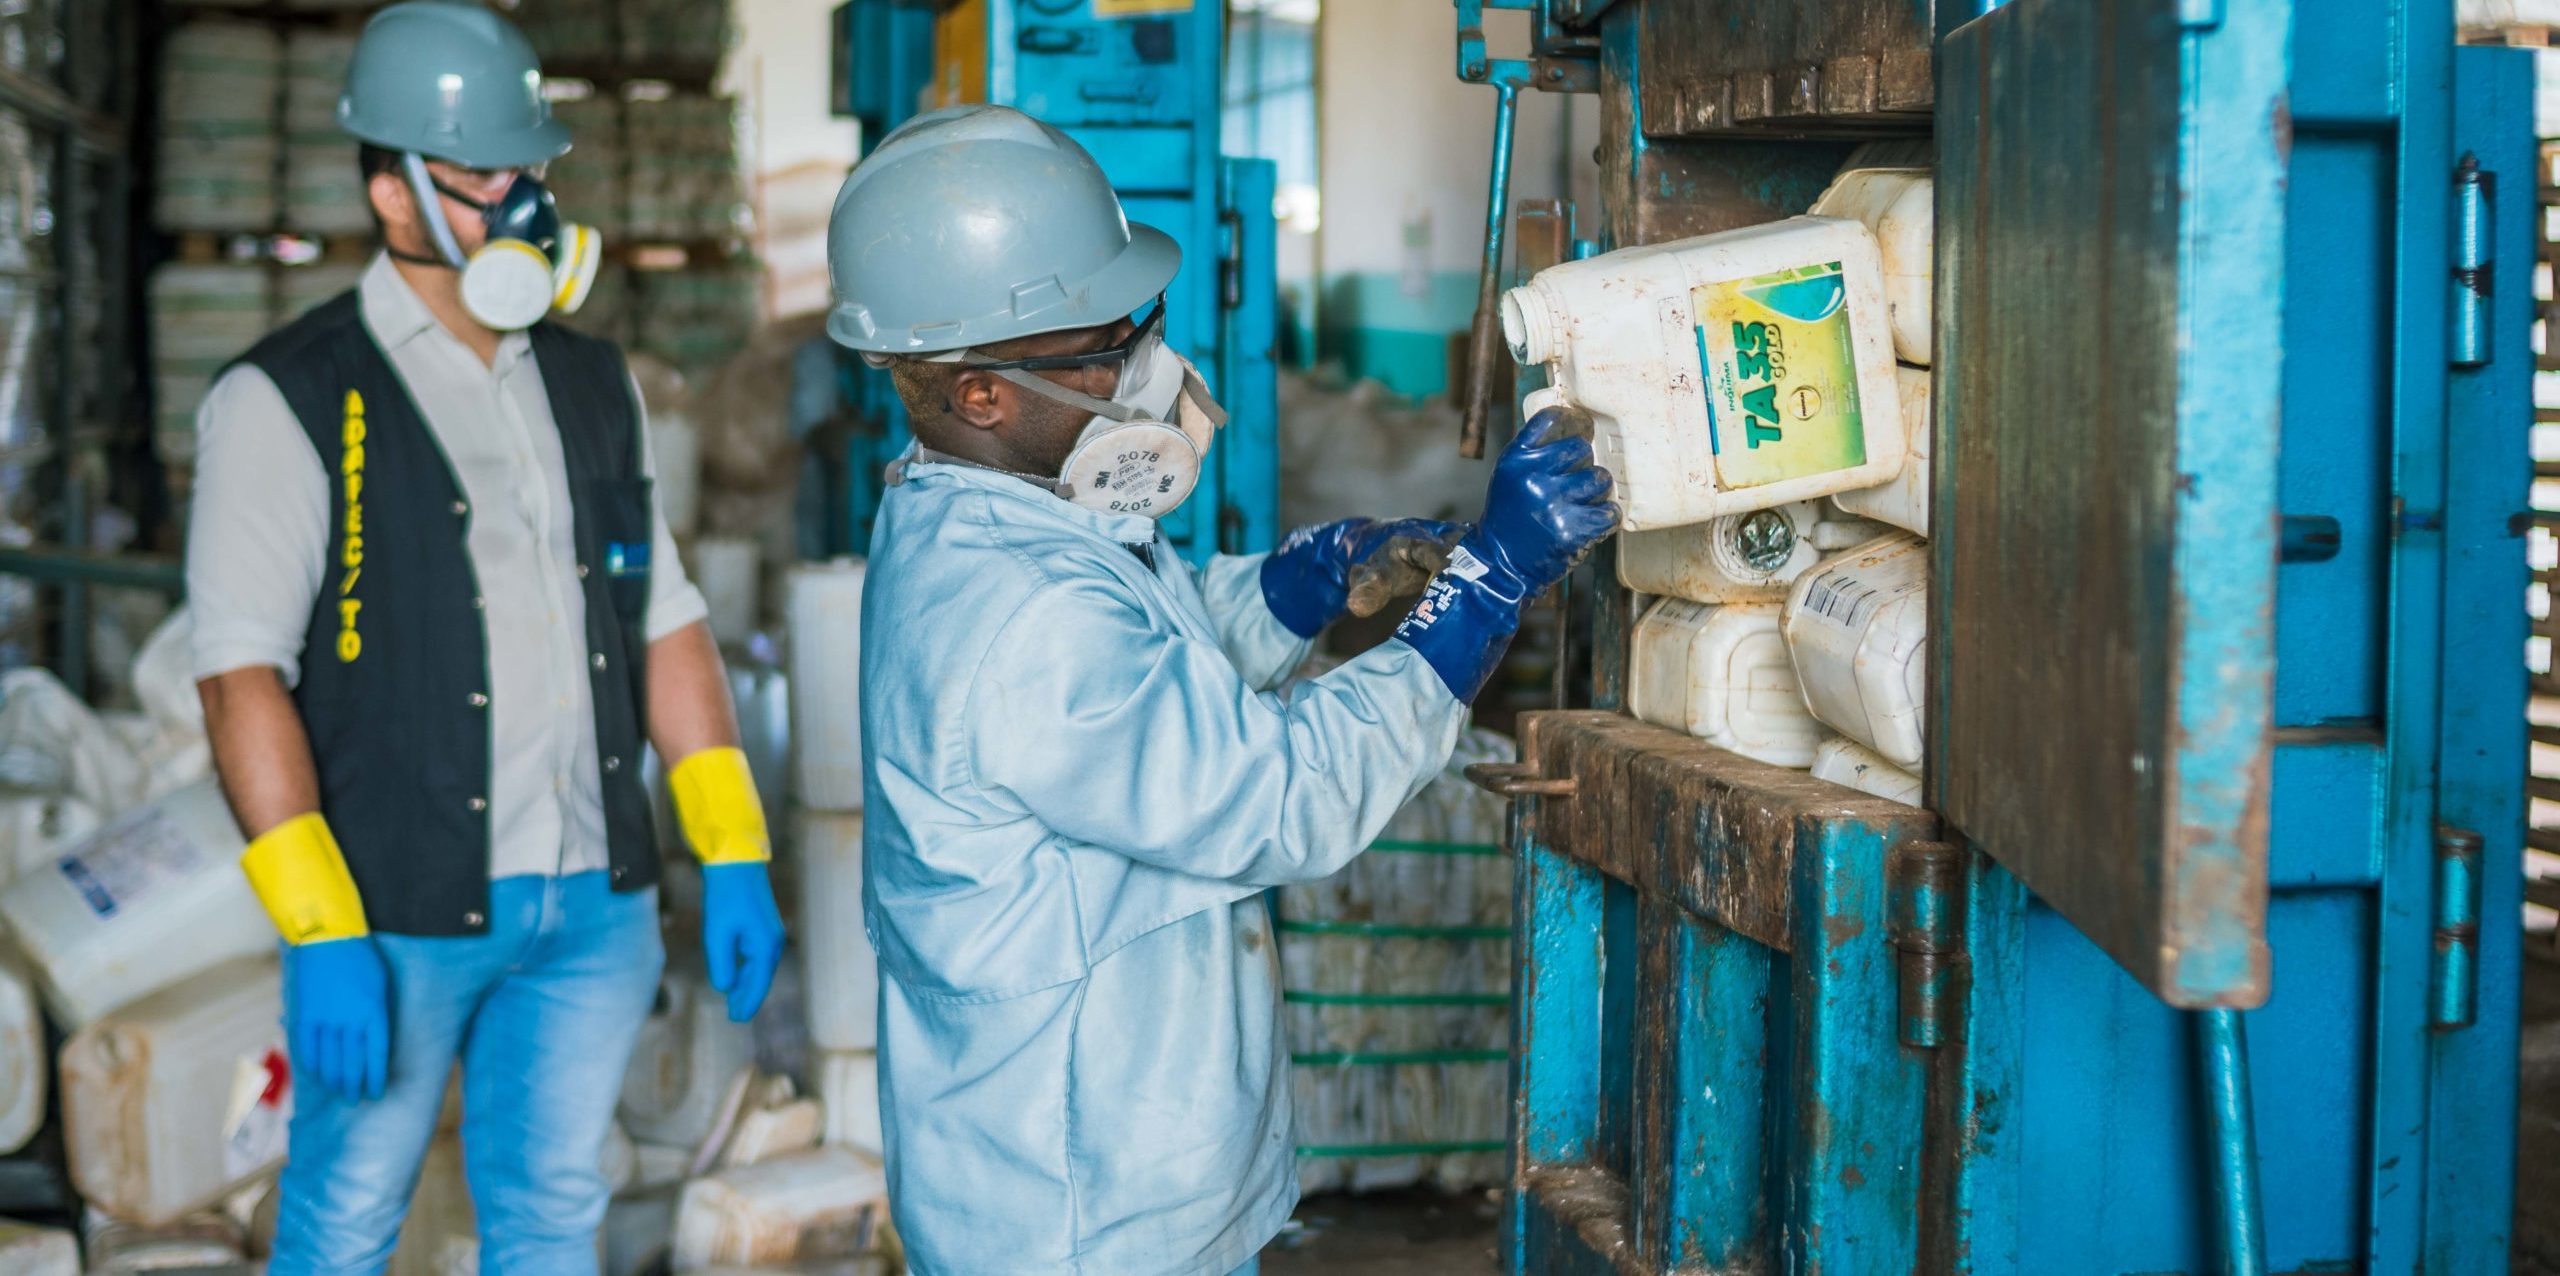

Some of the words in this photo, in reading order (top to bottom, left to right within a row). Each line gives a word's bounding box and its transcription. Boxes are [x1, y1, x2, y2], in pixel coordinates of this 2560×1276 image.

[1732, 320, 1772, 383] 35
[1766, 323, 1787, 382] GOLD
[1742, 384, 1782, 450] TA
[1117, 450, 1160, 464] 2078
[1094, 471, 1111, 489] 3M
[1110, 497, 1152, 512] 2078
